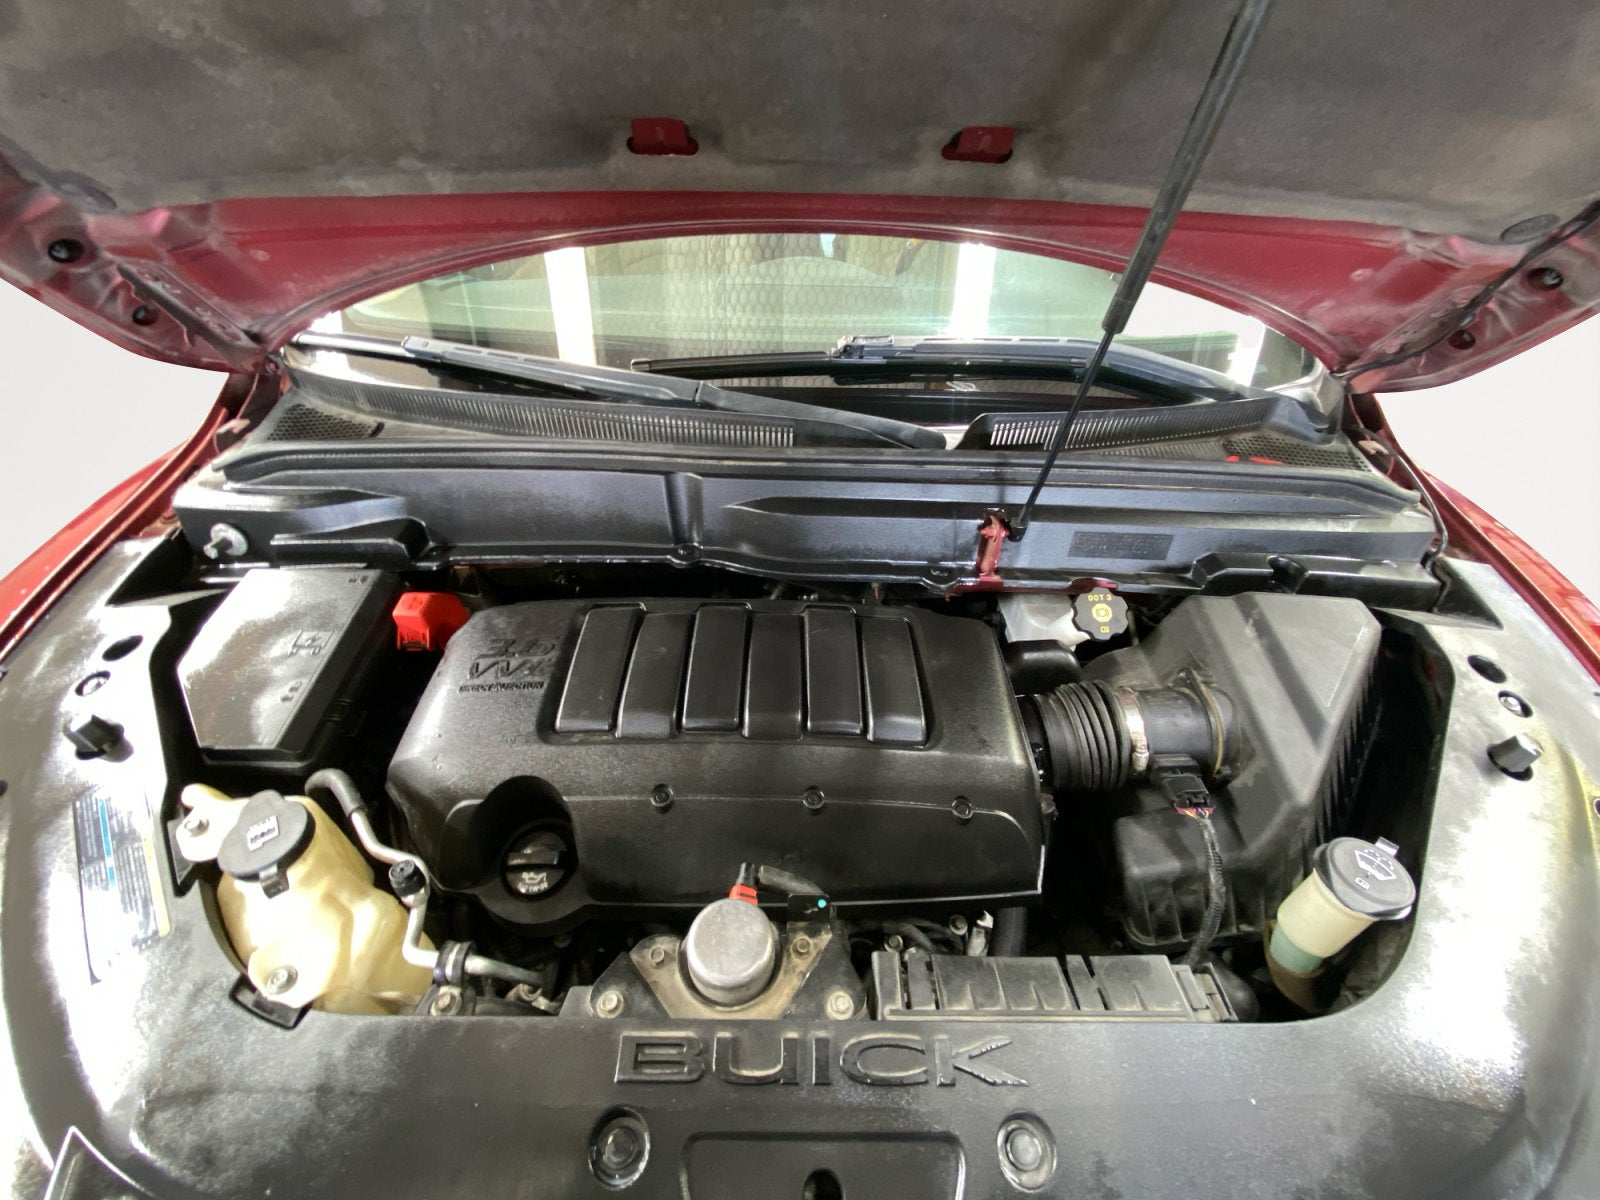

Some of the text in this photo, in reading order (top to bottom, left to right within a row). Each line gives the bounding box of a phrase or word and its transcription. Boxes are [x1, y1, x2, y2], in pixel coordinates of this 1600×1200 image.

[1105, 593, 1112, 601] 3
[472, 636, 560, 660] 3.6
[614, 1031, 1030, 1087] BUICK
